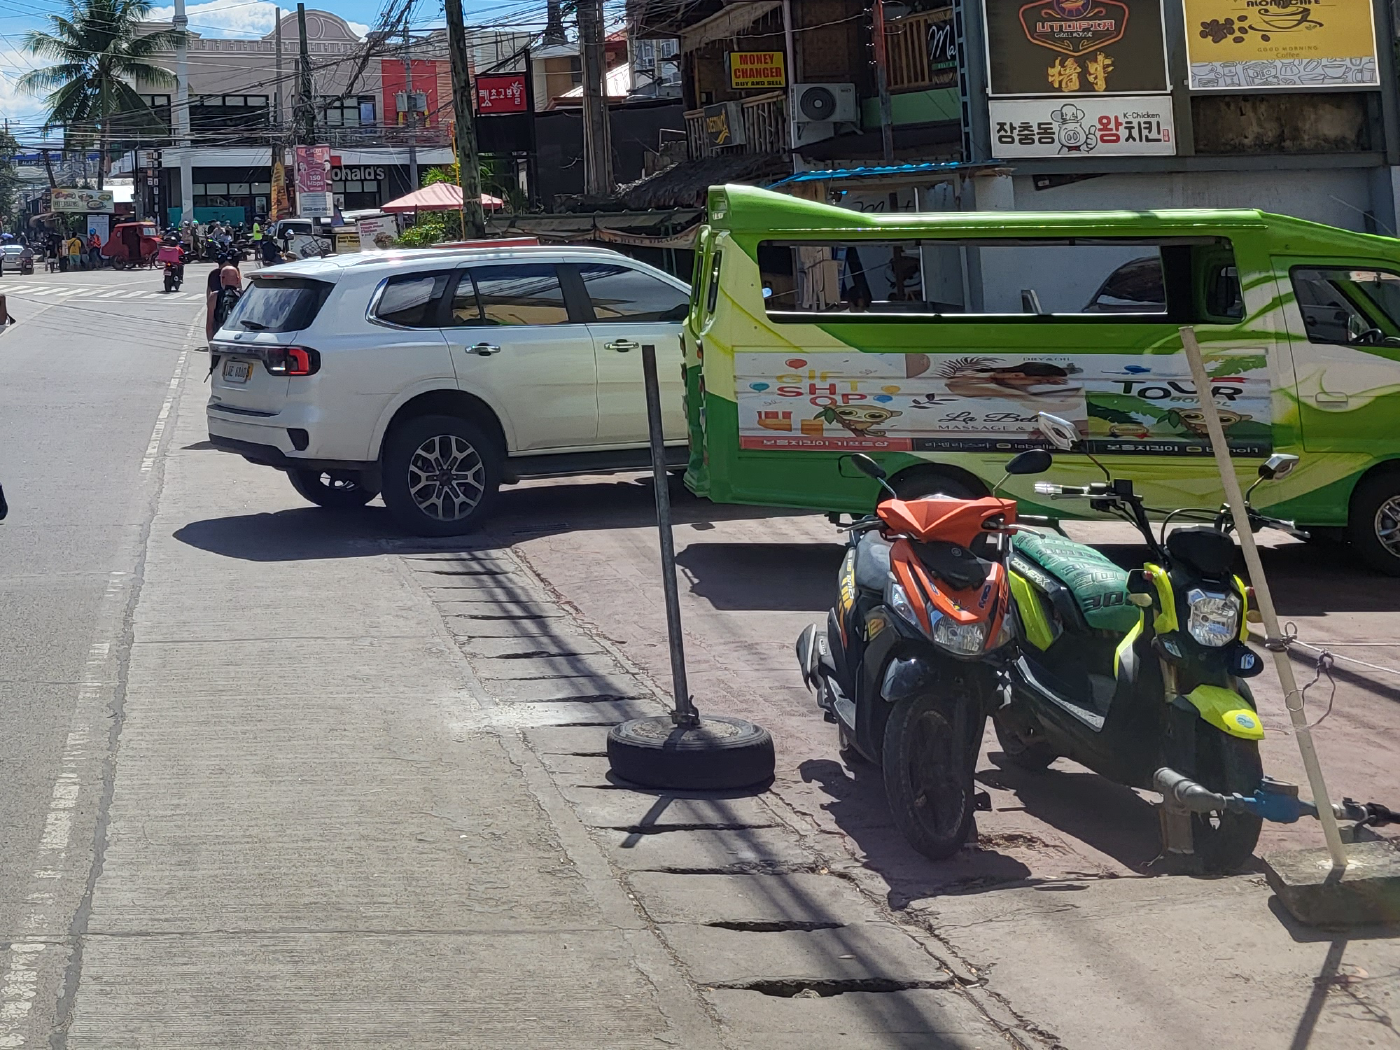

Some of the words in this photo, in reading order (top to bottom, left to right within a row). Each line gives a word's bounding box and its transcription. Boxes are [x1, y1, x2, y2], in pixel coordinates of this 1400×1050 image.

[1036, 19, 1115, 33] UTOPIA
[739, 53, 775, 66] MONEY
[1275, 51, 1300, 59] Coffee
[733, 66, 783, 79] CHANGER
[1123, 111, 1161, 119] K-Chicken
[996, 121, 1056, 145] 장충동
[1097, 115, 1163, 144] 왕치킨
[776, 369, 869, 392] GIFT
[776, 383, 868, 407] SHOP
[1112, 380, 1243, 401] TOUR
[938, 411, 977, 424] La
